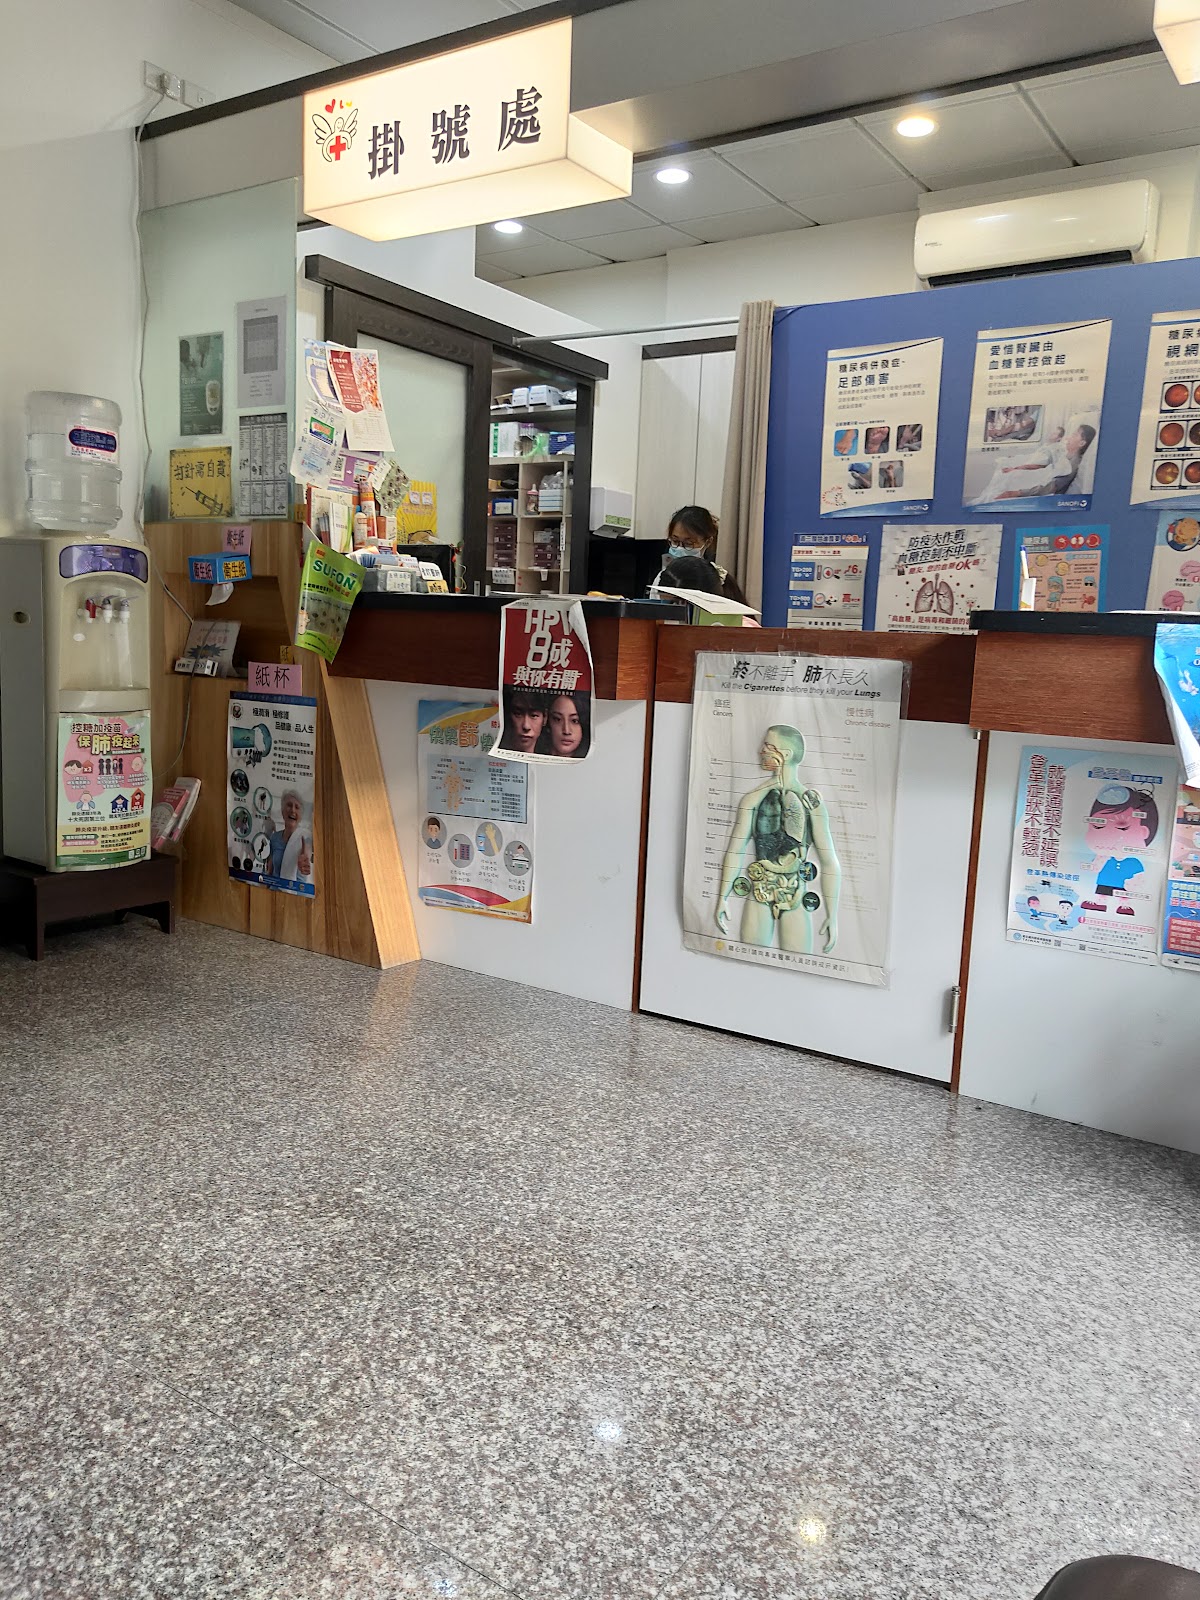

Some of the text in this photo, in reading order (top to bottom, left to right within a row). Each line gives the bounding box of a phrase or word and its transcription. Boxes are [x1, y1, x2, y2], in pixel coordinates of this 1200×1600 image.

[368, 86, 542, 179] 掛號處
[988, 354, 1066, 370] 血糖管控做起
[838, 373, 890, 389] 足部傷害
[907, 528, 966, 549] 防疫大作戰
[897, 542, 978, 564] 血糖控制不中斷
[312, 559, 356, 591] SUFON
[525, 631, 573, 669] 8成
[255, 665, 290, 688] 紙杯
[512, 665, 583, 690] 與你有關
[732, 660, 869, 686] 菸不離手 肺不長久
[732, 682, 743, 690] the
[743, 683, 785, 693] Cigarettes
[785, 685, 808, 694] before
[809, 687, 825, 696] they
[836, 689, 853, 697] your
[854, 689, 881, 698] Lungs
[845, 719, 868, 727] Chronic
[846, 706, 874, 718] 慢性病
[71, 723, 122, 733] 控糖加疫苗
[77, 734, 140, 755] 保肺疫起來
[1021, 754, 1048, 858] 登革症狀不輕忽
[1039, 765, 1067, 869] 就醫通報不延誤
